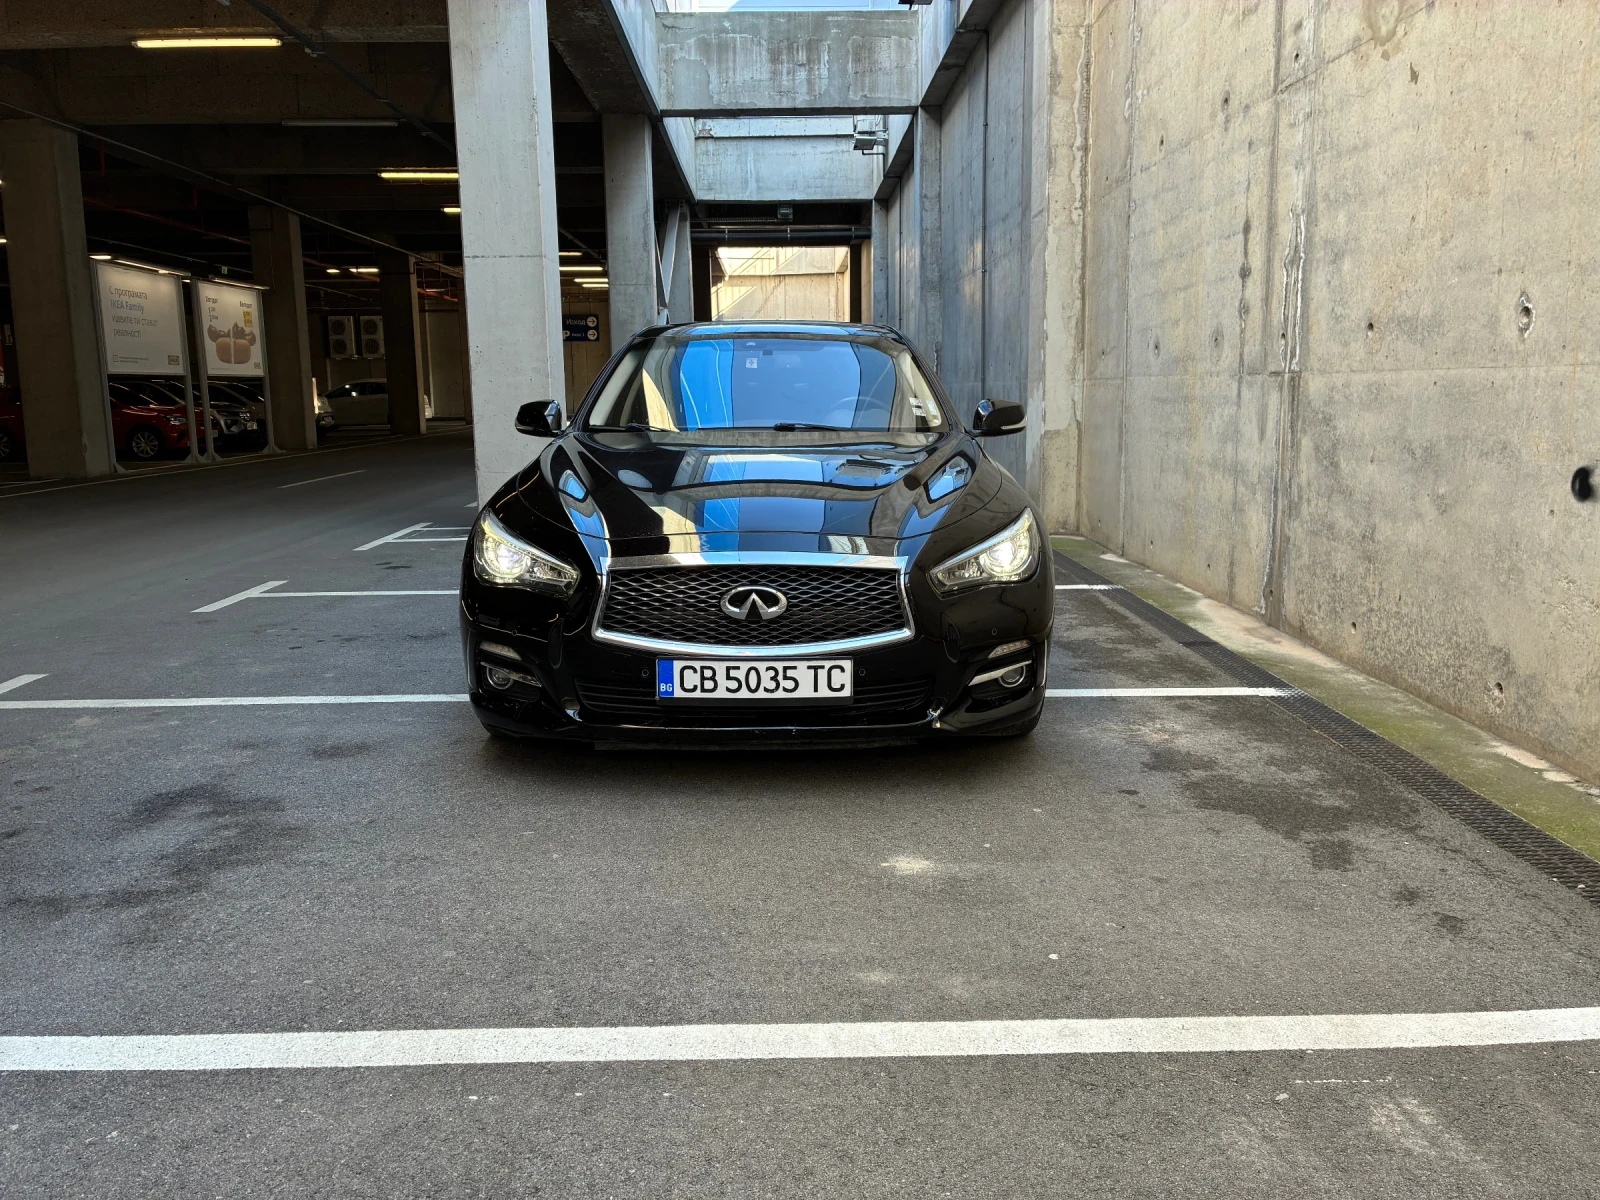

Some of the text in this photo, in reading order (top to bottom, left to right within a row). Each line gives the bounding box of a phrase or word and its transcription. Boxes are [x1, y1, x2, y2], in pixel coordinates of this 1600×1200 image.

[114, 287, 148, 300] програмата
[110, 299, 145, 314] IKEA Family
[660, 664, 846, 694] BG CB 5035 TC
